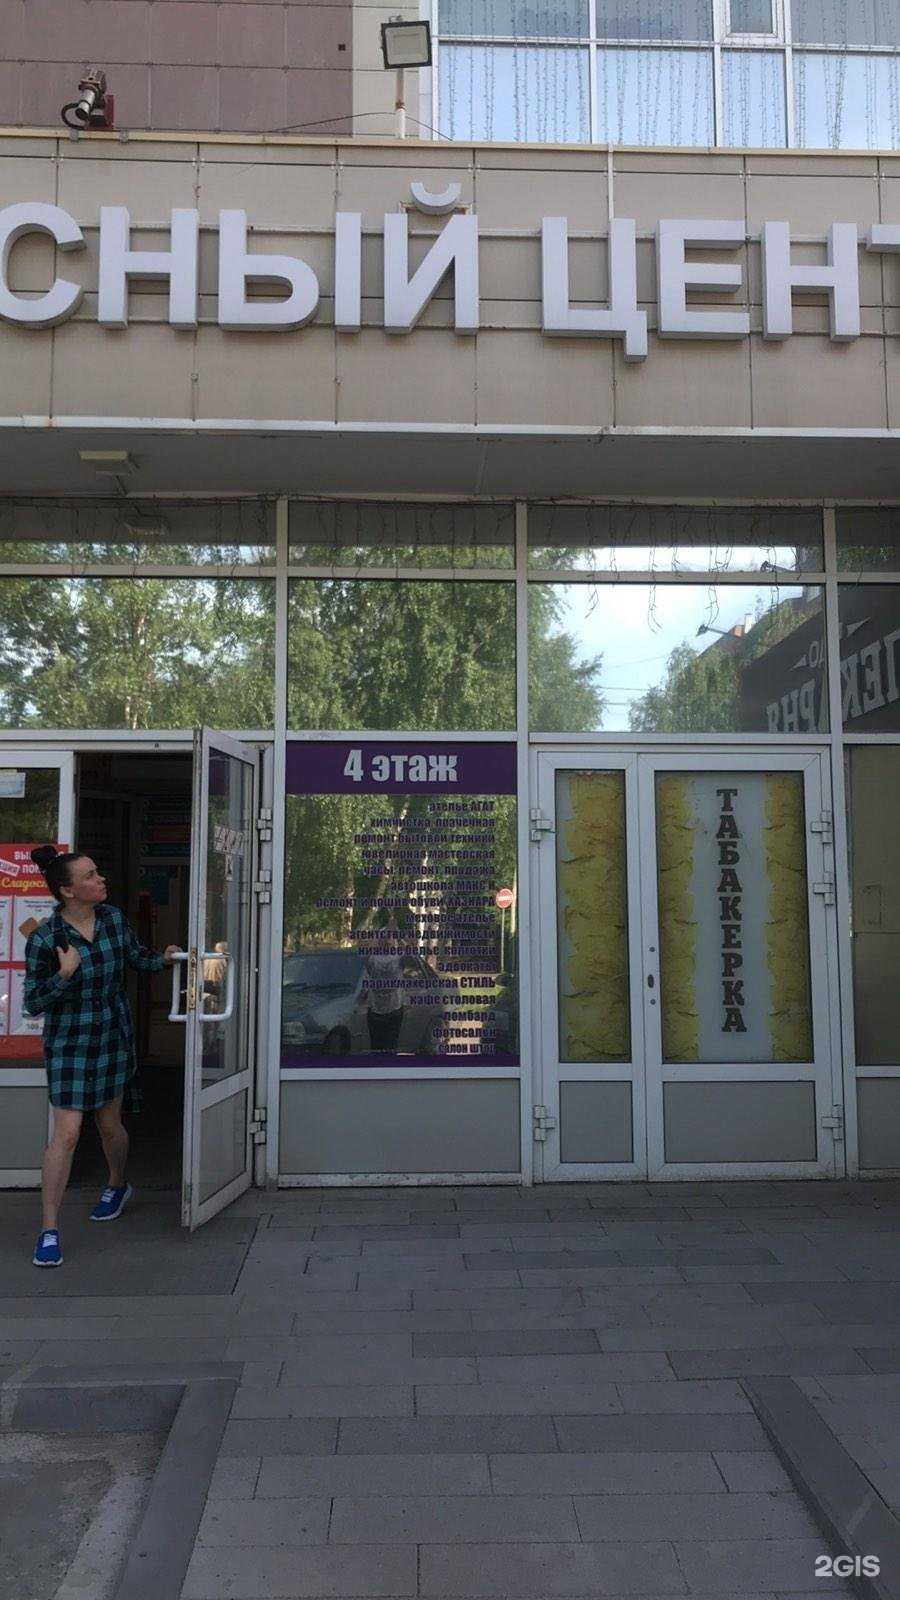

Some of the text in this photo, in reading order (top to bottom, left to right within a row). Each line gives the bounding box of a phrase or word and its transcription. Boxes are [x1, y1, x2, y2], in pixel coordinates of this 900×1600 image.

[0, 180, 480, 334] СНЫЙ
[343, 749, 459, 782] 4 этаж
[354, 833, 397, 844] ремонт
[716, 788, 748, 1033] ТАБАКЕРКА
[349, 929, 405, 940] агентство
[362, 976, 496, 989] парикмахерская СТИЛЬ
[410, 994, 496, 1005] кафе столовая
[443, 1010, 496, 1022] ломбард
[432, 1026, 496, 1039] фотосалон
[438, 1043, 468, 1054] салон
